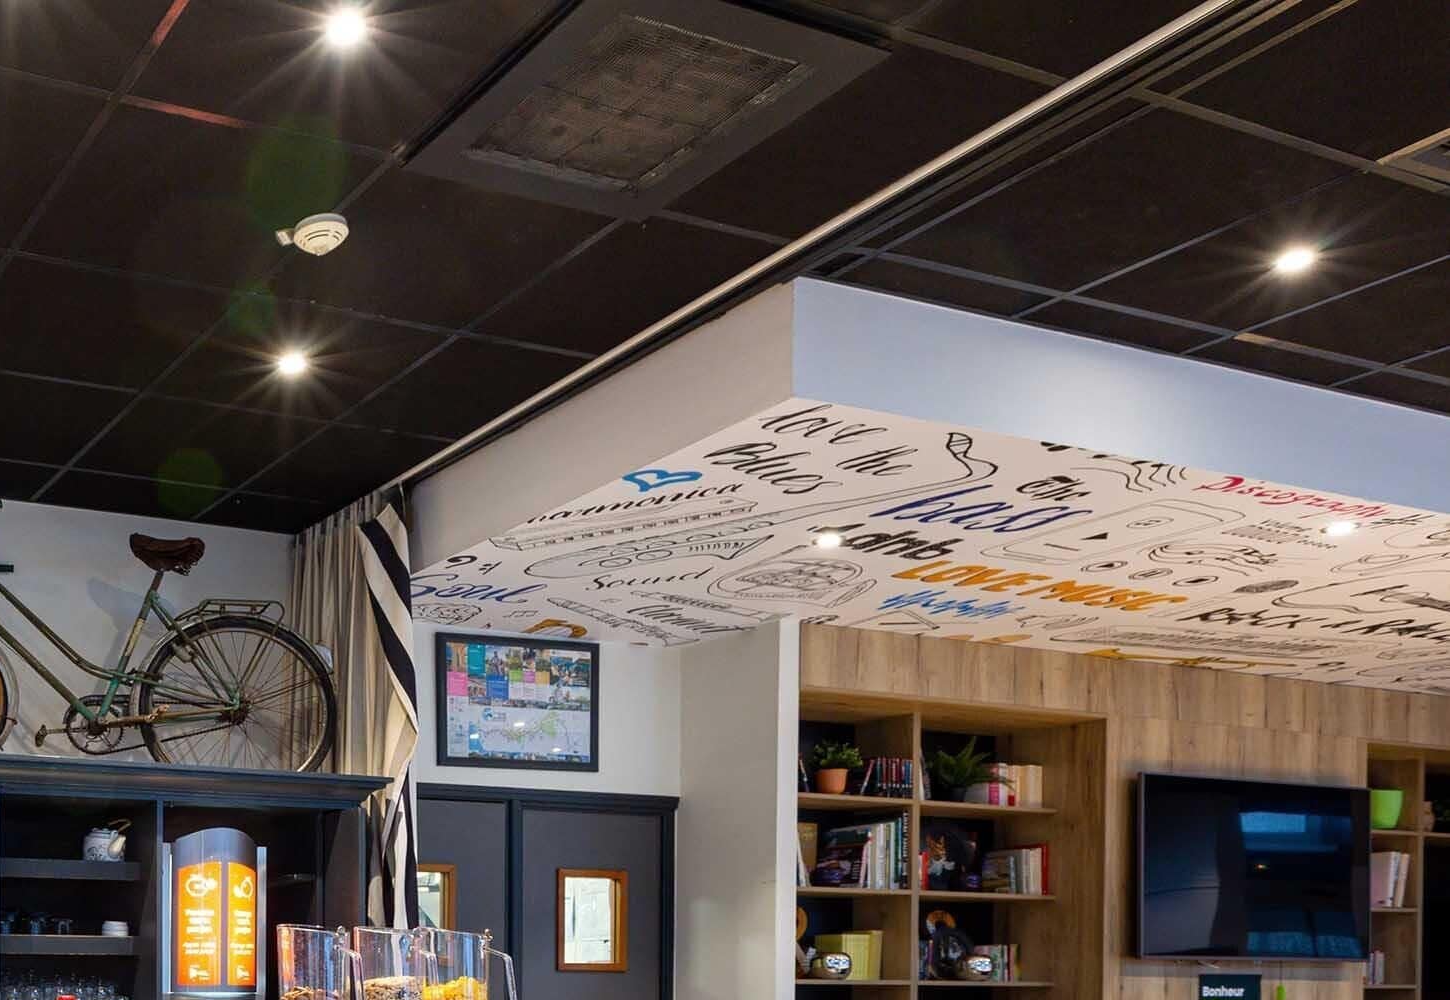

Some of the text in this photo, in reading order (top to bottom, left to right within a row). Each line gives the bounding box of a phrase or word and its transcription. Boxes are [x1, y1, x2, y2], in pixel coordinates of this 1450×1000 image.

[703, 443, 843, 494] Blues
[836, 445, 918, 476] the
[585, 566, 713, 591] Sound
[891, 560, 1053, 592] LOVE
[1015, 580, 1189, 611] MUSIC
[1202, 986, 1245, 997] Bonheur
